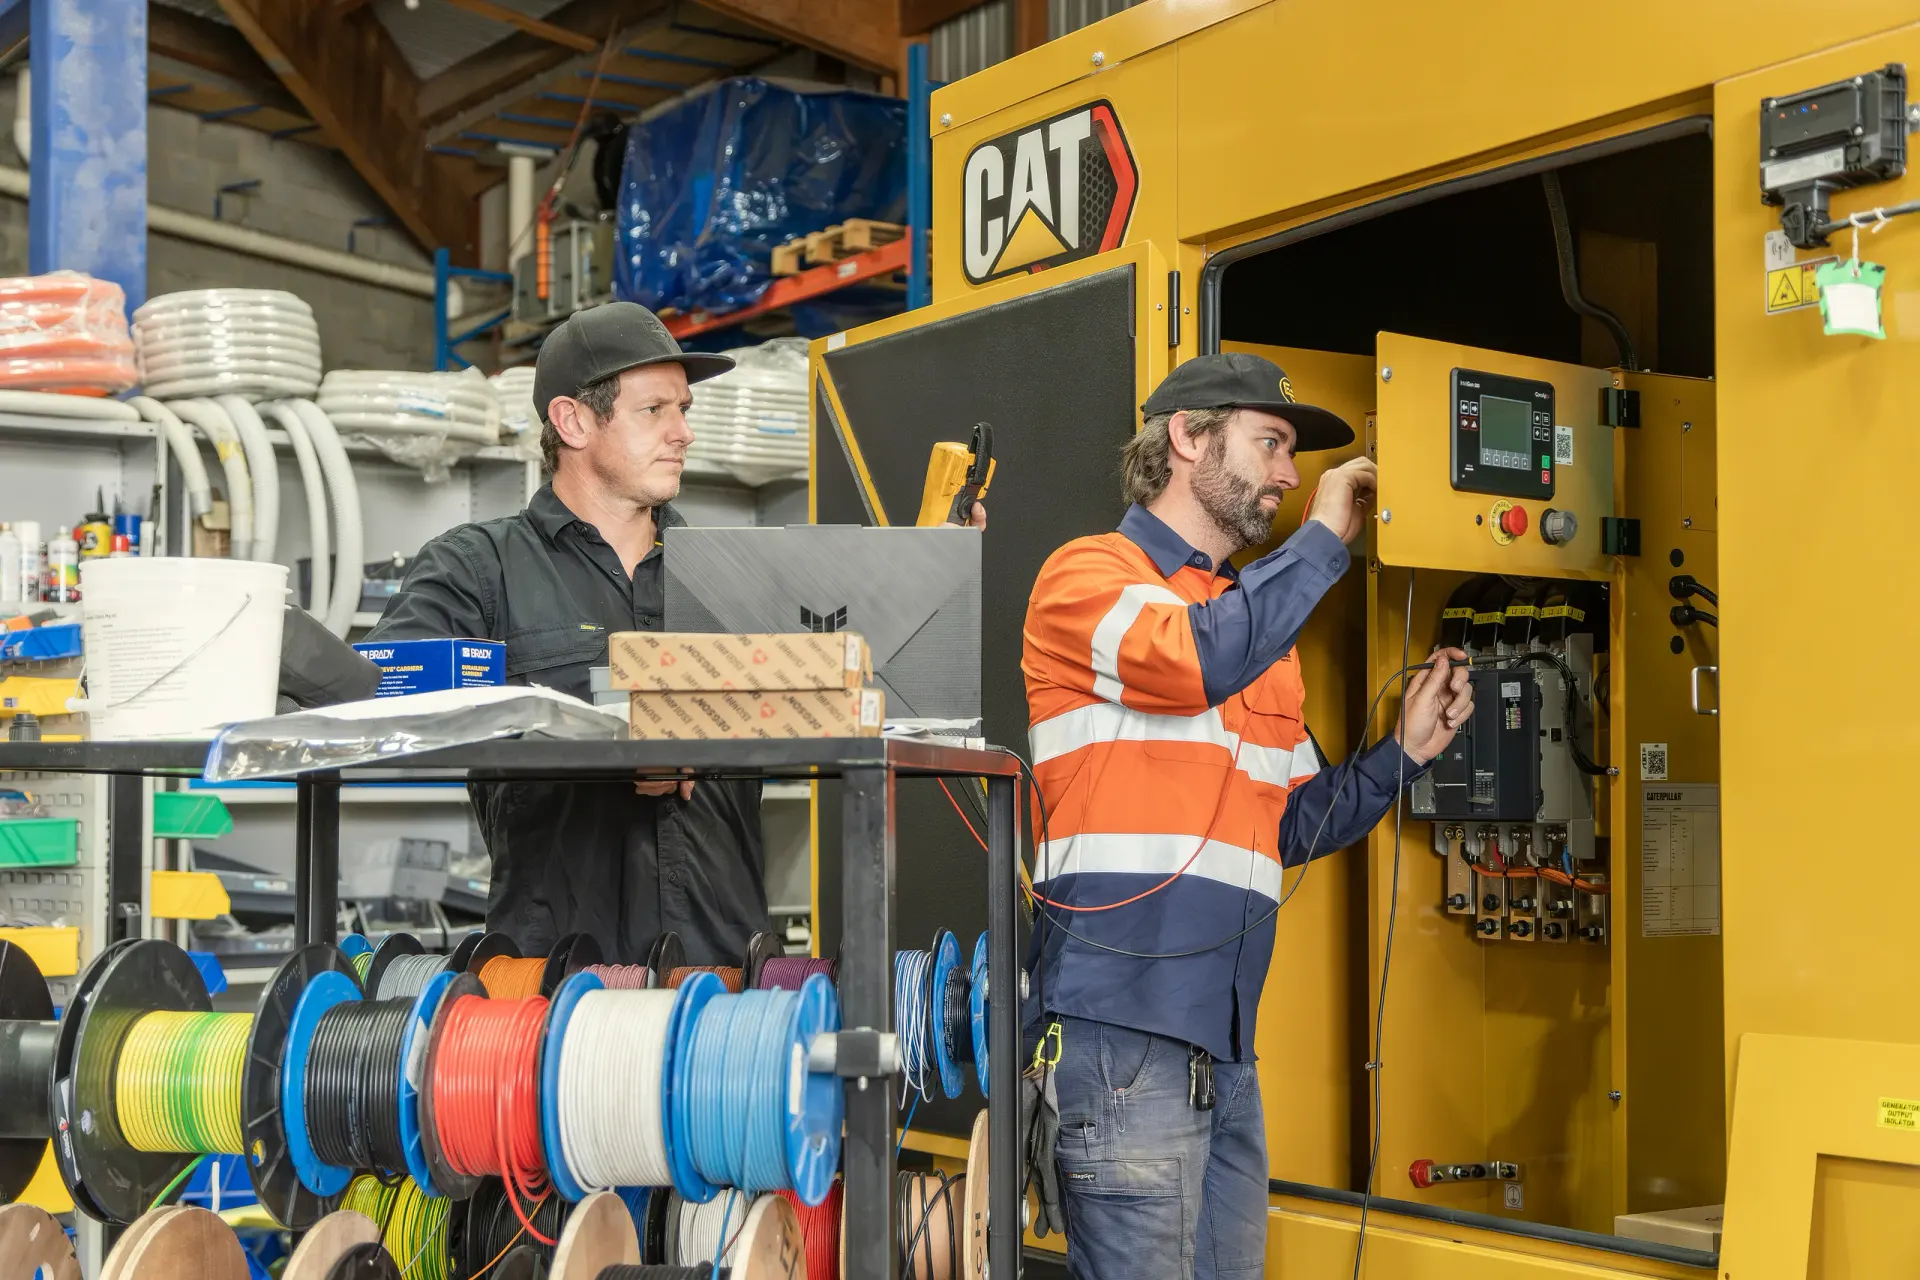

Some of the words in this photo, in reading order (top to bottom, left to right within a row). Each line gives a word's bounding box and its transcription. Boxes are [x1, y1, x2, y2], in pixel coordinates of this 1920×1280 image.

[965, 109, 1091, 279] CAT
[368, 649, 395, 660] BRADY
[470, 648, 492, 660] BRADY
[1646, 792, 1683, 801] CATERPILLAR
[1887, 1109, 1913, 1118] OUTPUT
